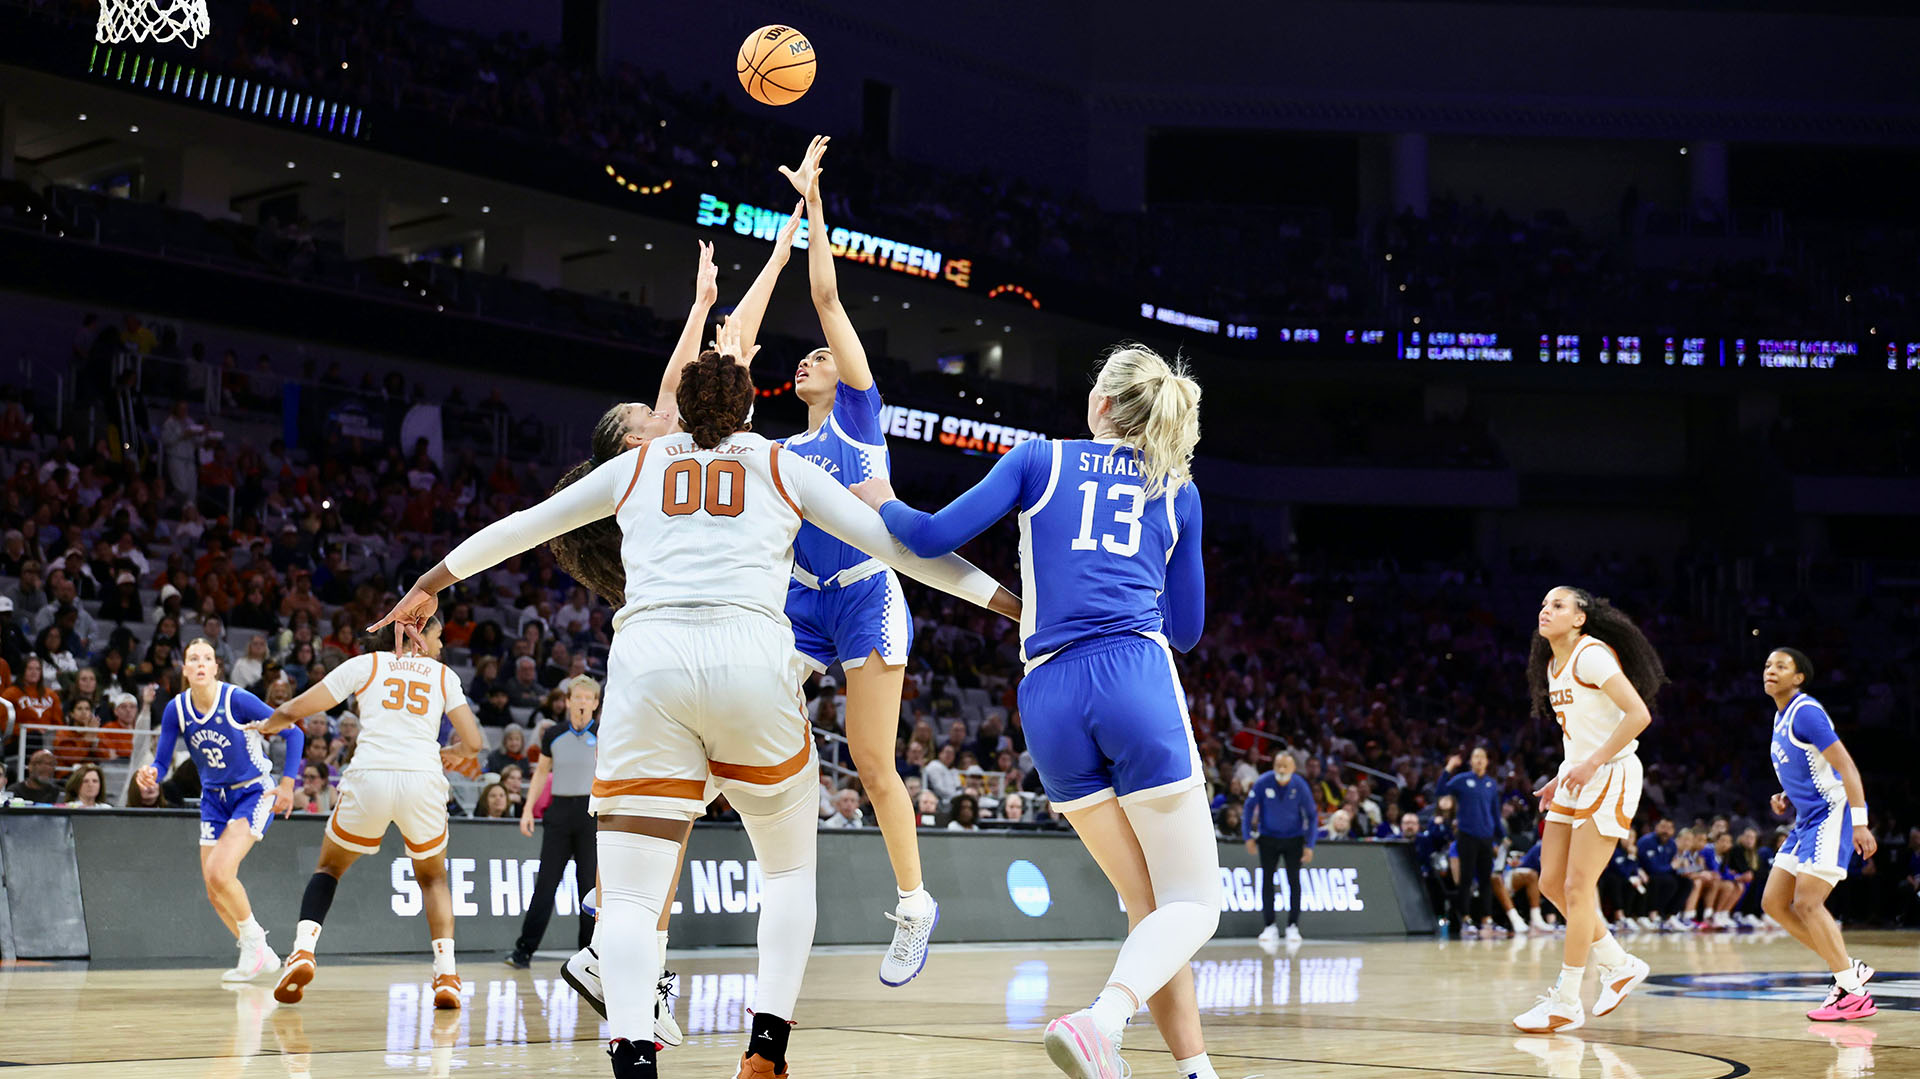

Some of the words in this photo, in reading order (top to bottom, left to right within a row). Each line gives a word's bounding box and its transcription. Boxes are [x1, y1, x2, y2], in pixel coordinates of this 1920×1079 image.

[733, 203, 829, 250] SWE
[1809, 354, 1836, 369] KEY
[879, 403, 940, 442] WEET
[939, 416, 1046, 455] SIXTEE
[661, 457, 747, 518] 00
[1071, 480, 1146, 558] 13
[388, 660, 432, 677] BOOKER
[381, 677, 432, 716] 35
[190, 729, 232, 750] KENTUCKY
[201, 747, 227, 769] 32
